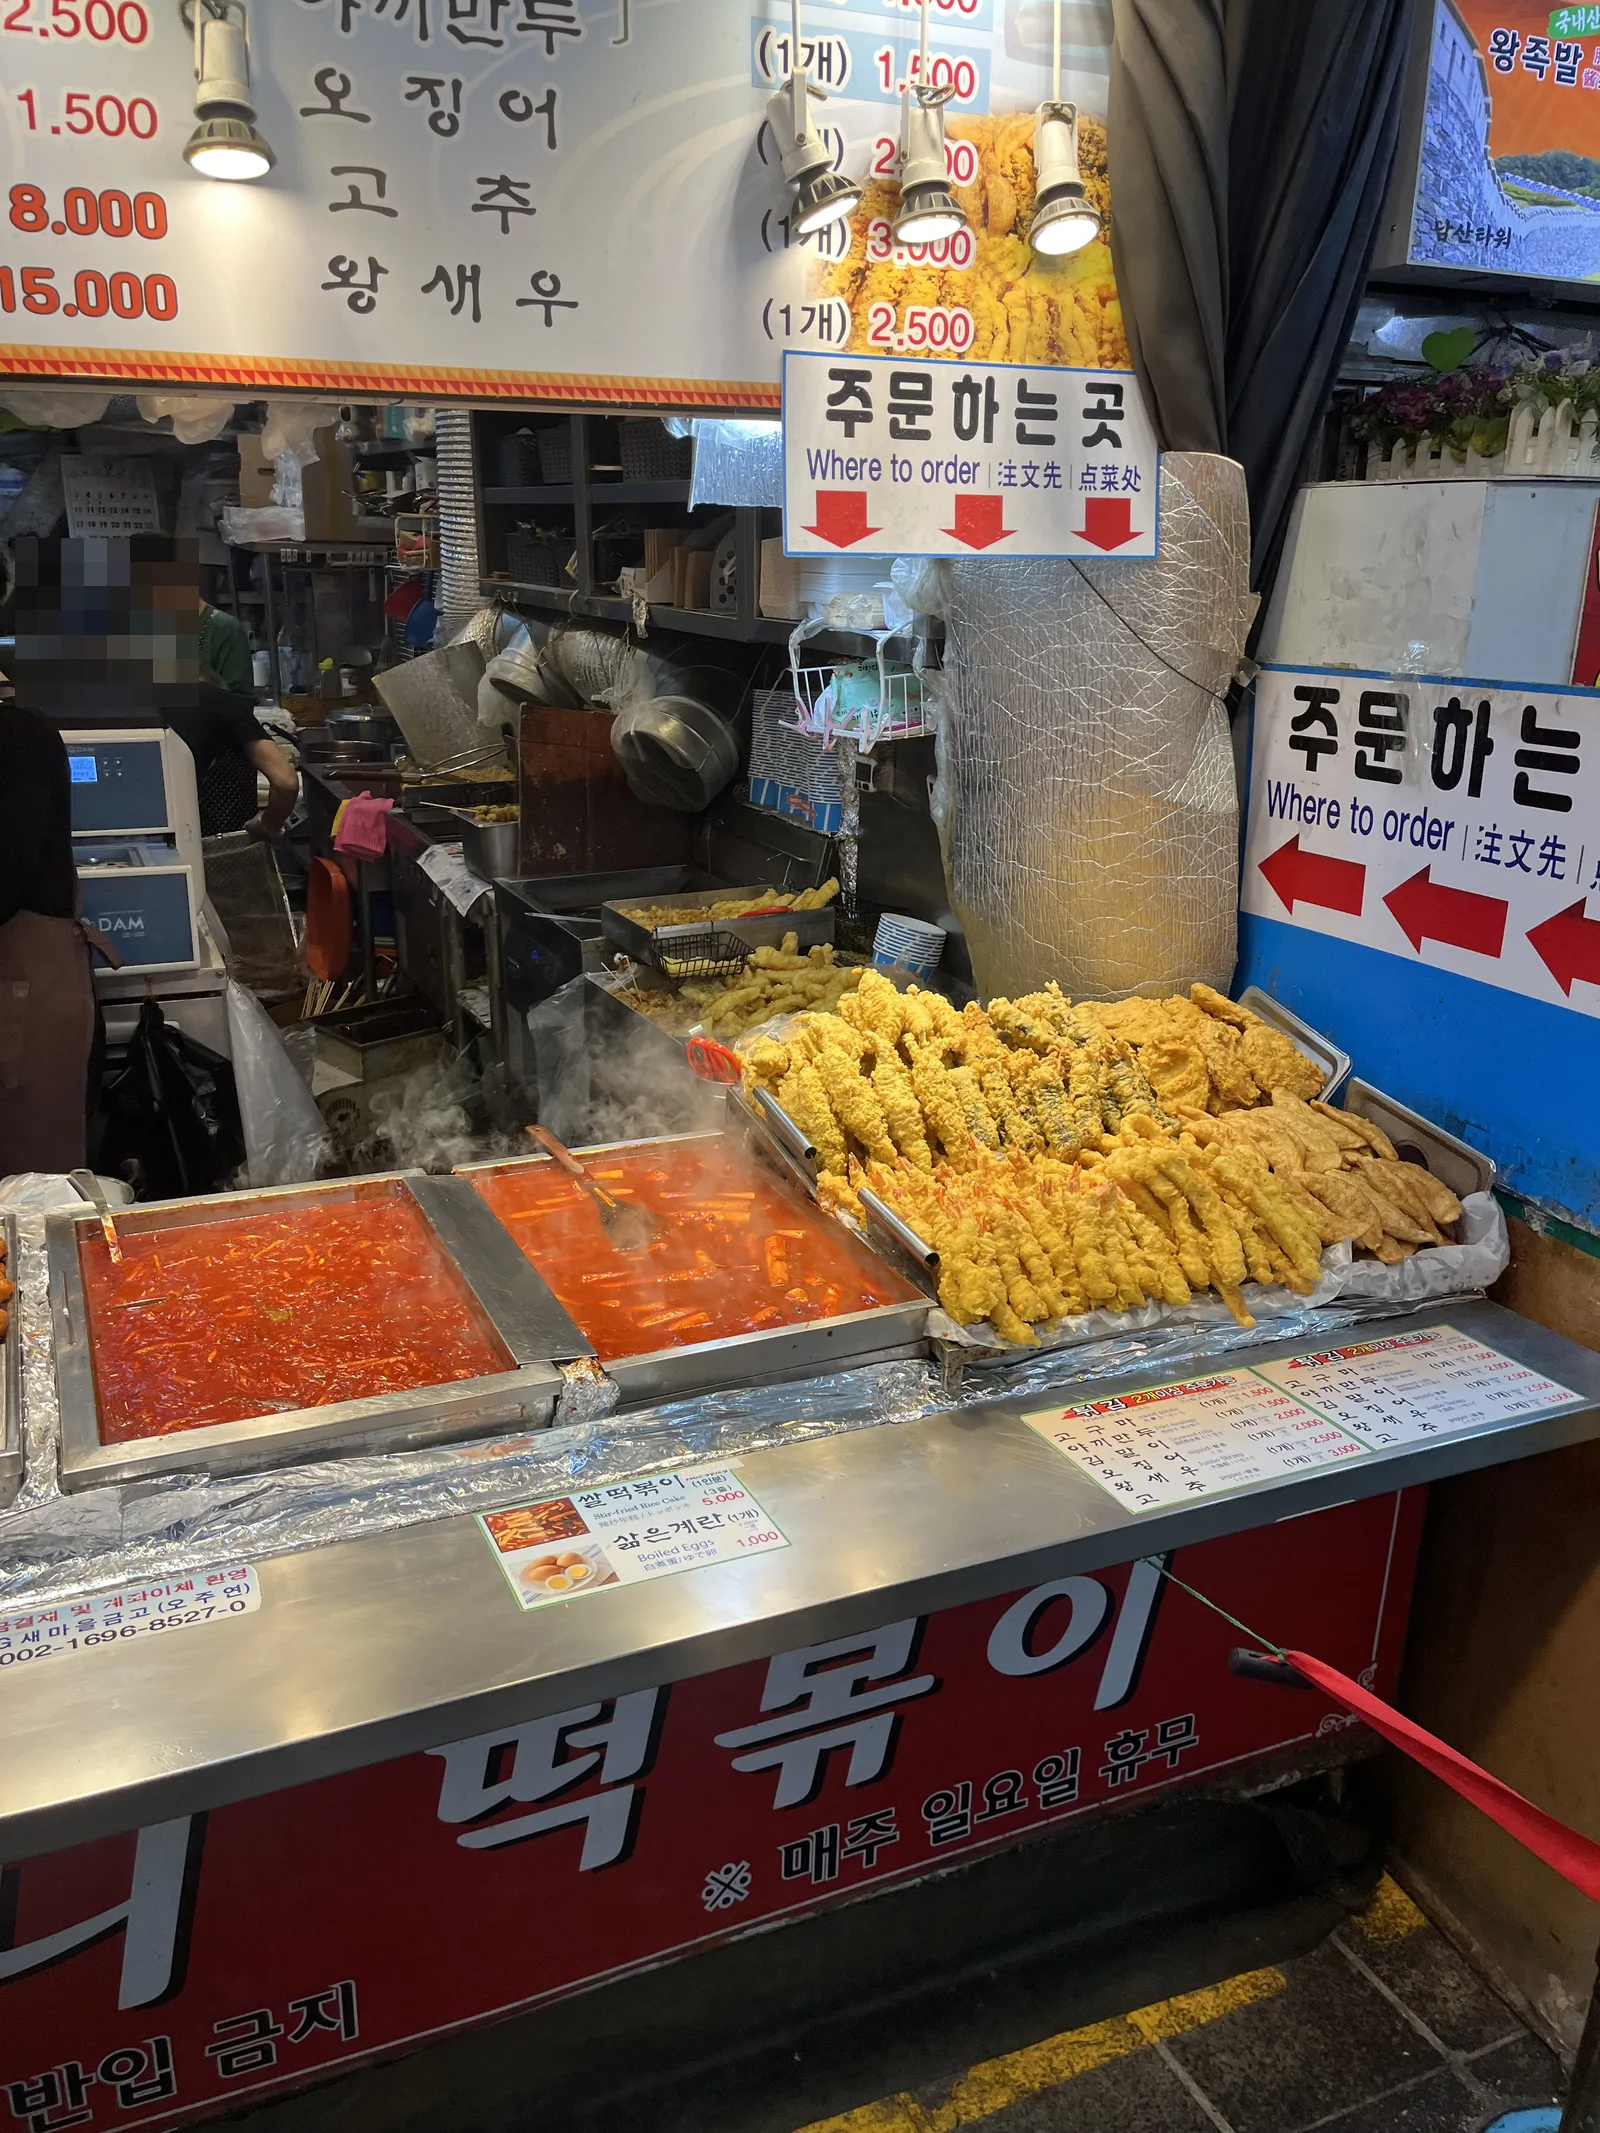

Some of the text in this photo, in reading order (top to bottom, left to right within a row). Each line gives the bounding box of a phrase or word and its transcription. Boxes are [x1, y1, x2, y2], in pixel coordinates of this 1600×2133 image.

[1, 0, 149, 44] 2.500
[1489, 28, 1583, 84] 왕족발
[17, 88, 159, 140] 1.500
[875, 137, 974, 182] 2.0
[8, 183, 168, 241] 8.000
[1434, 219, 1512, 249] 남산타워
[0, 265, 179, 322] 15.000
[762, 298, 847, 343] (1개)
[871, 307, 970, 347] 2.500
[826, 367, 1125, 449] 주문하는 곳
[806, 447, 980, 485] Where to order
[997, 458, 1063, 490] 注文先
[1078, 463, 1142, 493] 点菜处
[1289, 685, 1581, 813] 주문하는
[1268, 779, 1455, 851] Where to order
[1475, 823, 1567, 880] 注文先
[1130, 1385, 1184, 1404] 2개이상
[578, 1474, 685, 1509] 쌀떡볶이
[593, 1495, 685, 1520] Stir-fried Rice Cake
[702, 1490, 745, 1506] 5.000
[613, 1513, 725, 1550] 삶은계란
[727, 1509, 760, 1523] (1개)
[637, 1539, 715, 1562] Boiled Eggs
[737, 1531, 779, 1548] 1.000
[71, 1602, 92, 1618] 및
[104, 1580, 195, 1609] 계좌이체
[205, 1567, 249, 1586] 환영
[781, 1807, 900, 1884] 매주
[922, 1748, 1081, 1847] 일요일
[1099, 1713, 1199, 1788] 휴무
[3, 1980, 359, 2133] 반입 금지
